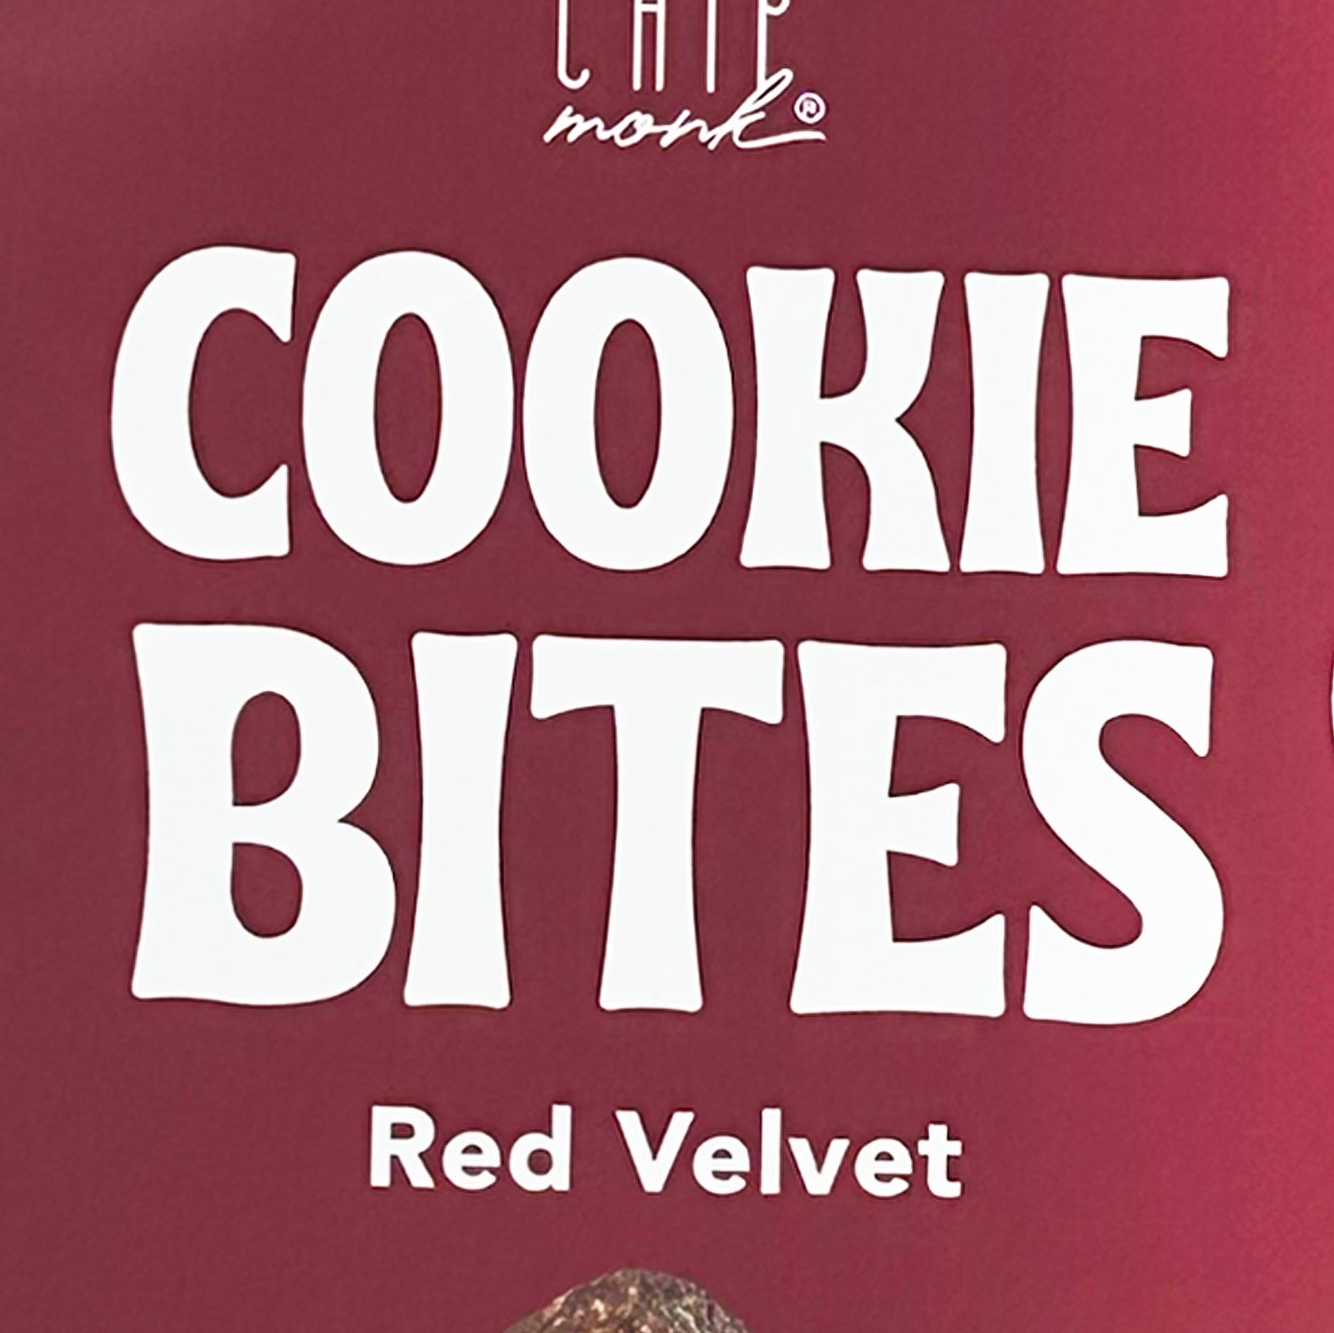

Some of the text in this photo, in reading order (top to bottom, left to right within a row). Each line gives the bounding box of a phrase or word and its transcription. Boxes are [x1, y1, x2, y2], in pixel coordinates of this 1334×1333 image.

[111, 246, 1230, 578] COOKIE
[131, 623, 1224, 1025] BITES
[370, 1104, 963, 1199] Red Velvet
